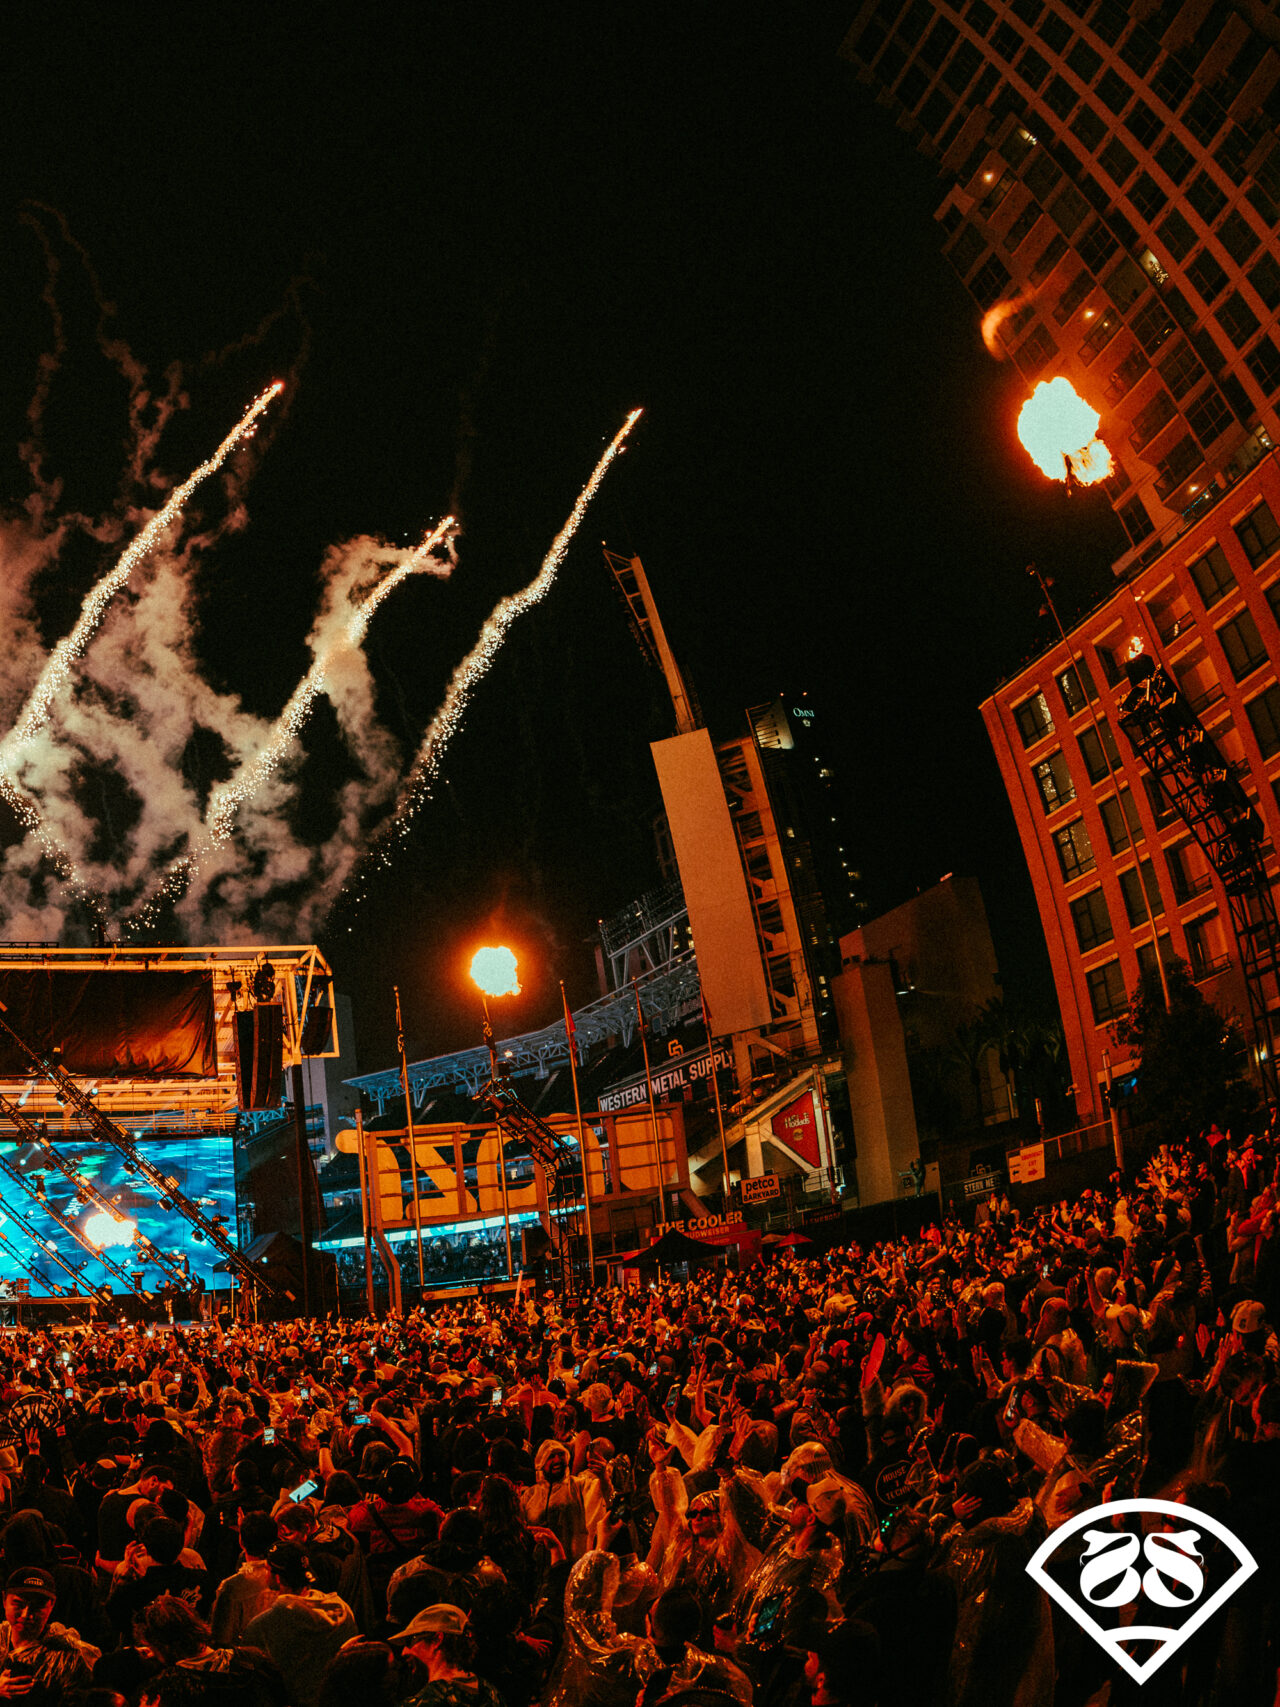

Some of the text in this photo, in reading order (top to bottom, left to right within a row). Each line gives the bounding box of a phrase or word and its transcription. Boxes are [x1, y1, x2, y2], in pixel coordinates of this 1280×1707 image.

[599, 1051, 734, 1112] WESTERN METAL SUPPLY
[743, 1188, 779, 1202] BARKYARD
[745, 1177, 775, 1194] petco
[655, 1211, 744, 1236] THE COOLER
